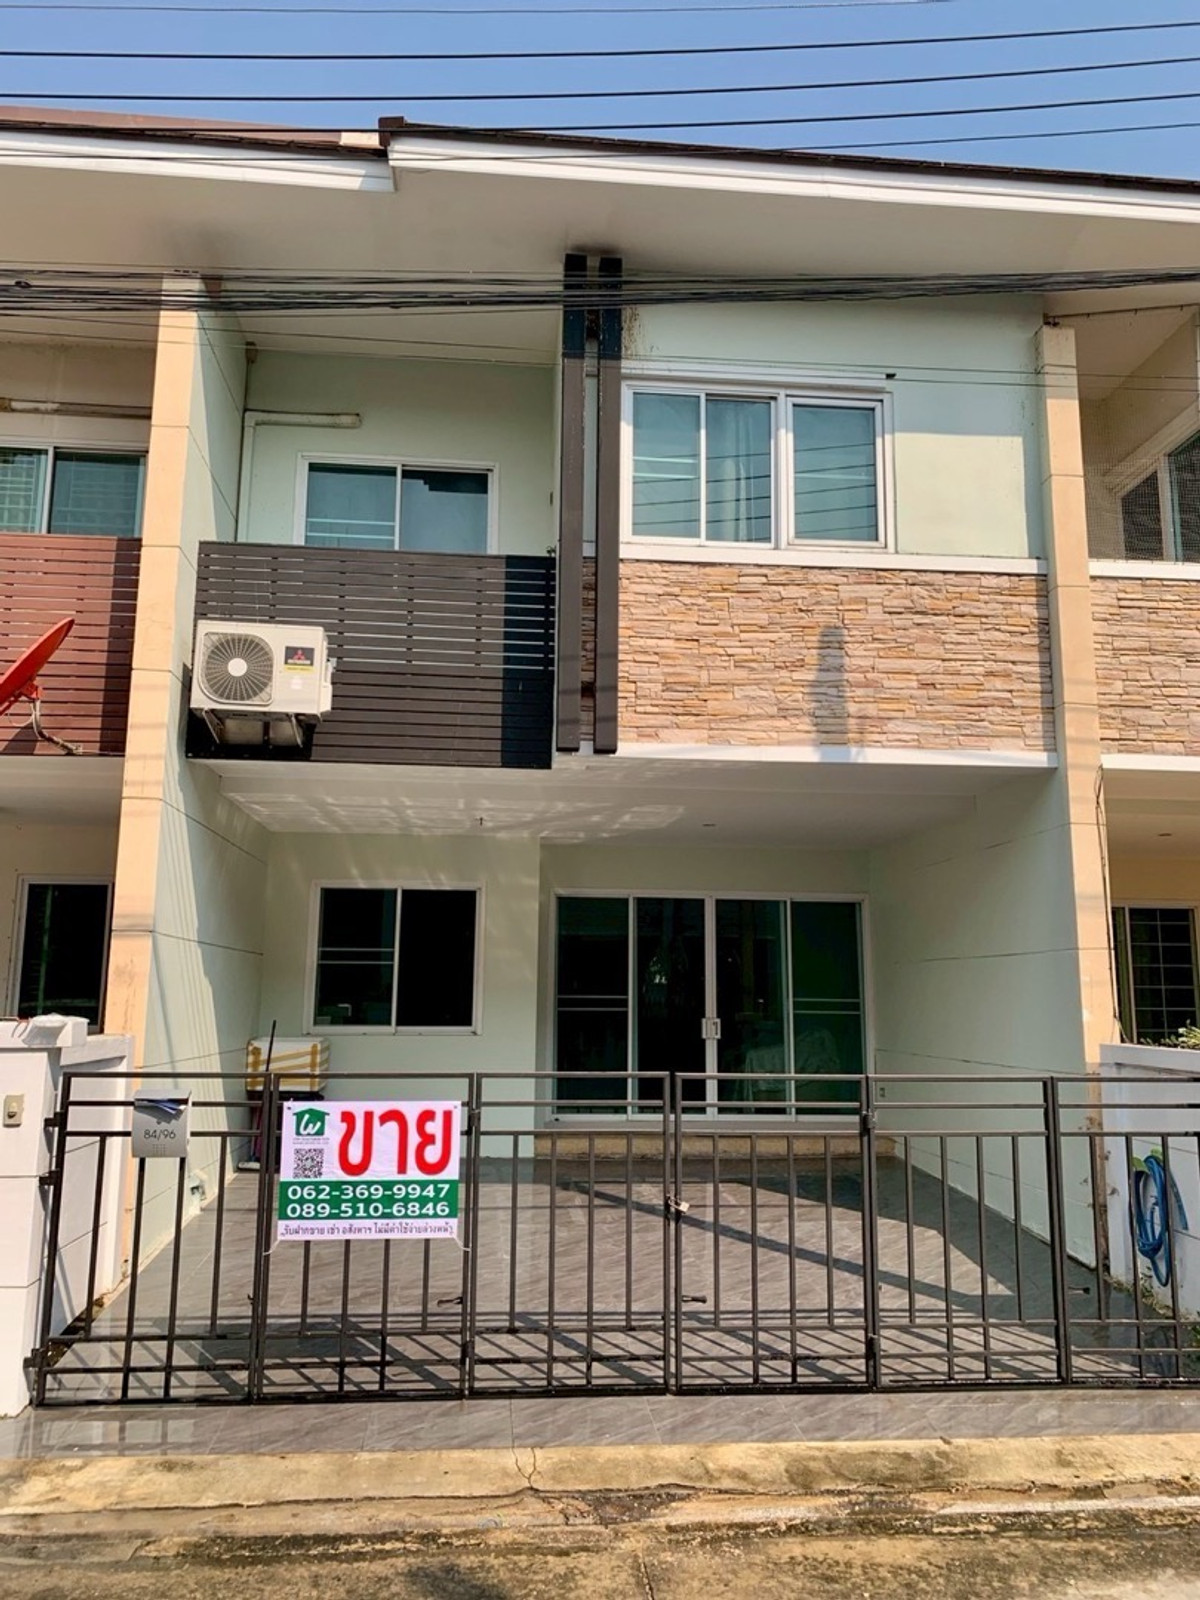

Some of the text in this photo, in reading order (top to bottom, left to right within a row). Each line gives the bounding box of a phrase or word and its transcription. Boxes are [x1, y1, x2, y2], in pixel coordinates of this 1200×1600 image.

[144, 1129, 176, 1141] 84/96
[339, 1109, 452, 1176] ขาย
[288, 1184, 449, 1199] 062-369-9947
[287, 1202, 449, 1217] 089-510-6846
